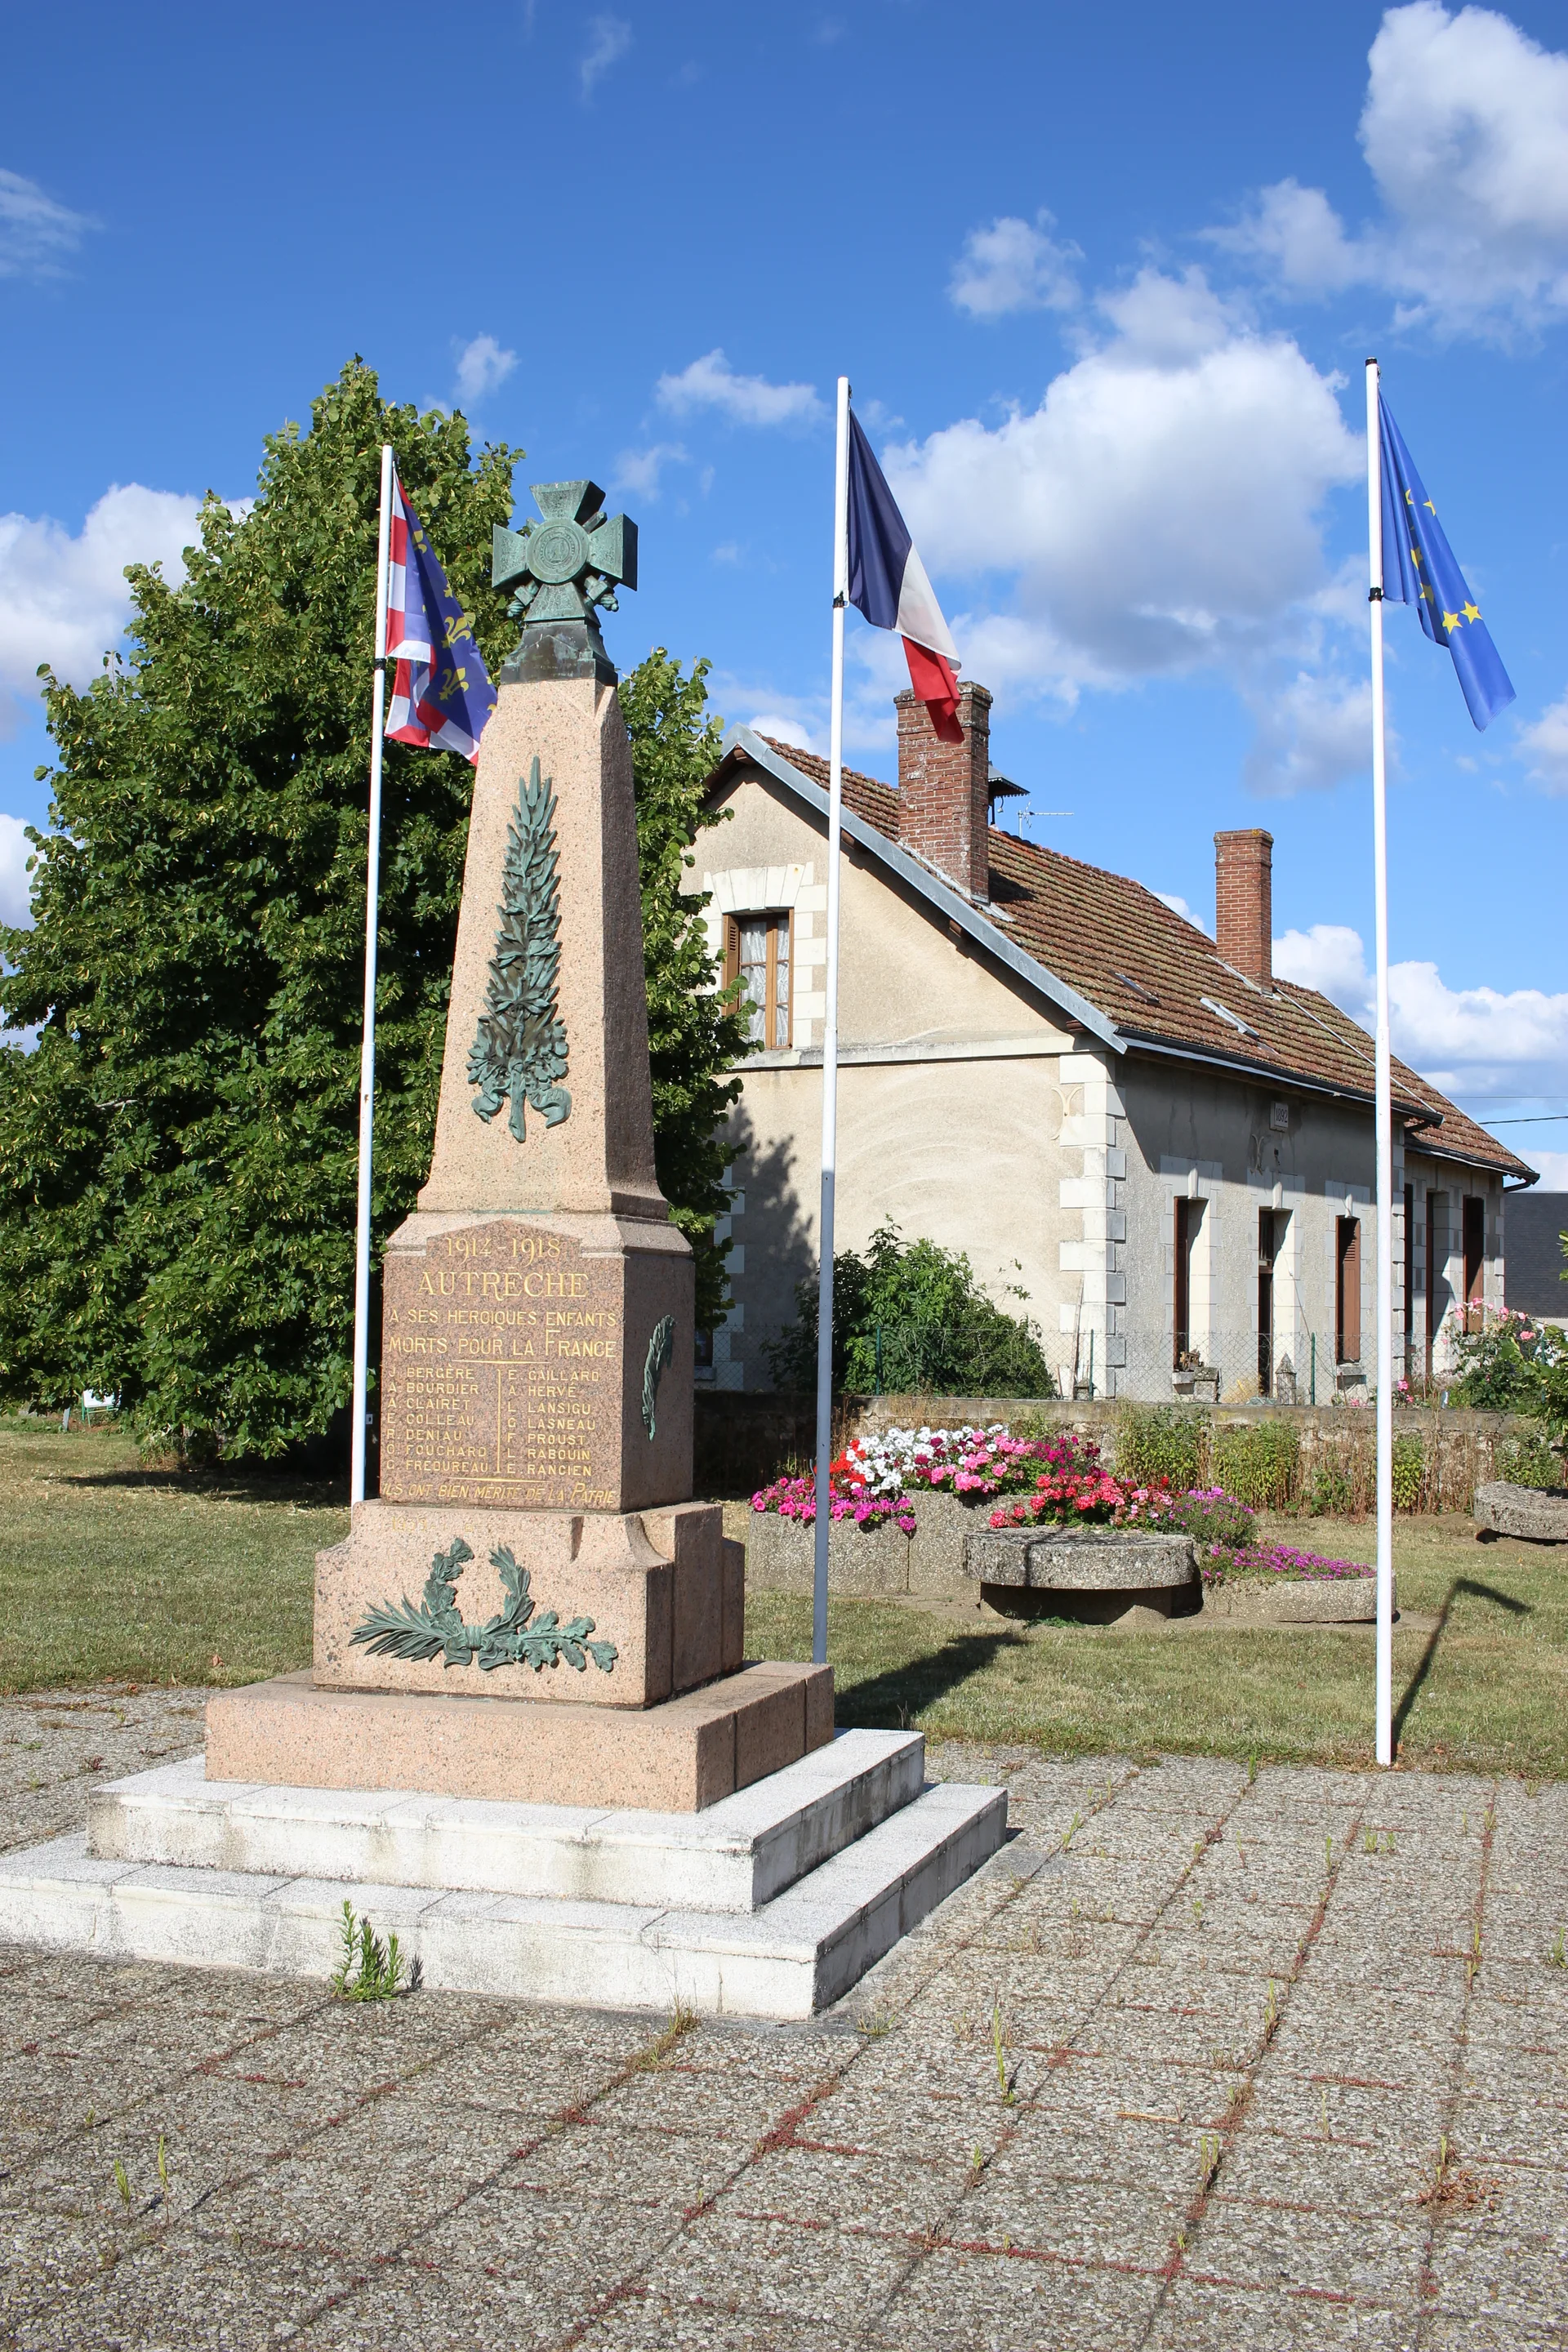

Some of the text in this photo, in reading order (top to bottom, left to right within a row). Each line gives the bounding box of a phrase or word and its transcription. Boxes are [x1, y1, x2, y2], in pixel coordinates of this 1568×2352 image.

[1276, 1107, 1288, 1123] 1892
[389, 1310, 617, 1331] A SES HEROIQUES ENFANTS
[388, 1330, 617, 1358] MORTS POUR LA FRANCE
[407, 1363, 475, 1379] BERGÈRE
[528, 1370, 600, 1382] GAILLARD
[406, 1382, 479, 1395] BOURDIER
[528, 1381, 577, 1397] HERVÉ
[407, 1397, 470, 1410] CLAIRET
[528, 1401, 591, 1415] LANSIGU
[406, 1413, 474, 1425] COLLEAU
[528, 1418, 595, 1430] LASNEAU
[406, 1428, 462, 1441] DENIAU
[528, 1433, 586, 1446] PROUST
[406, 1444, 487, 1457] FOUCHARD
[528, 1448, 590, 1460] RABOUIN
[406, 1459, 488, 1472] FREDUREAU
[528, 1463, 592, 1477] RANCIEN
[383, 1483, 403, 1495] ILS
[408, 1484, 434, 1497] ONT
[439, 1484, 470, 1498] BIEN
[525, 1487, 546, 1501] DE
[548, 1488, 564, 1503] LA
[570, 1481, 617, 1503] PATRIE
